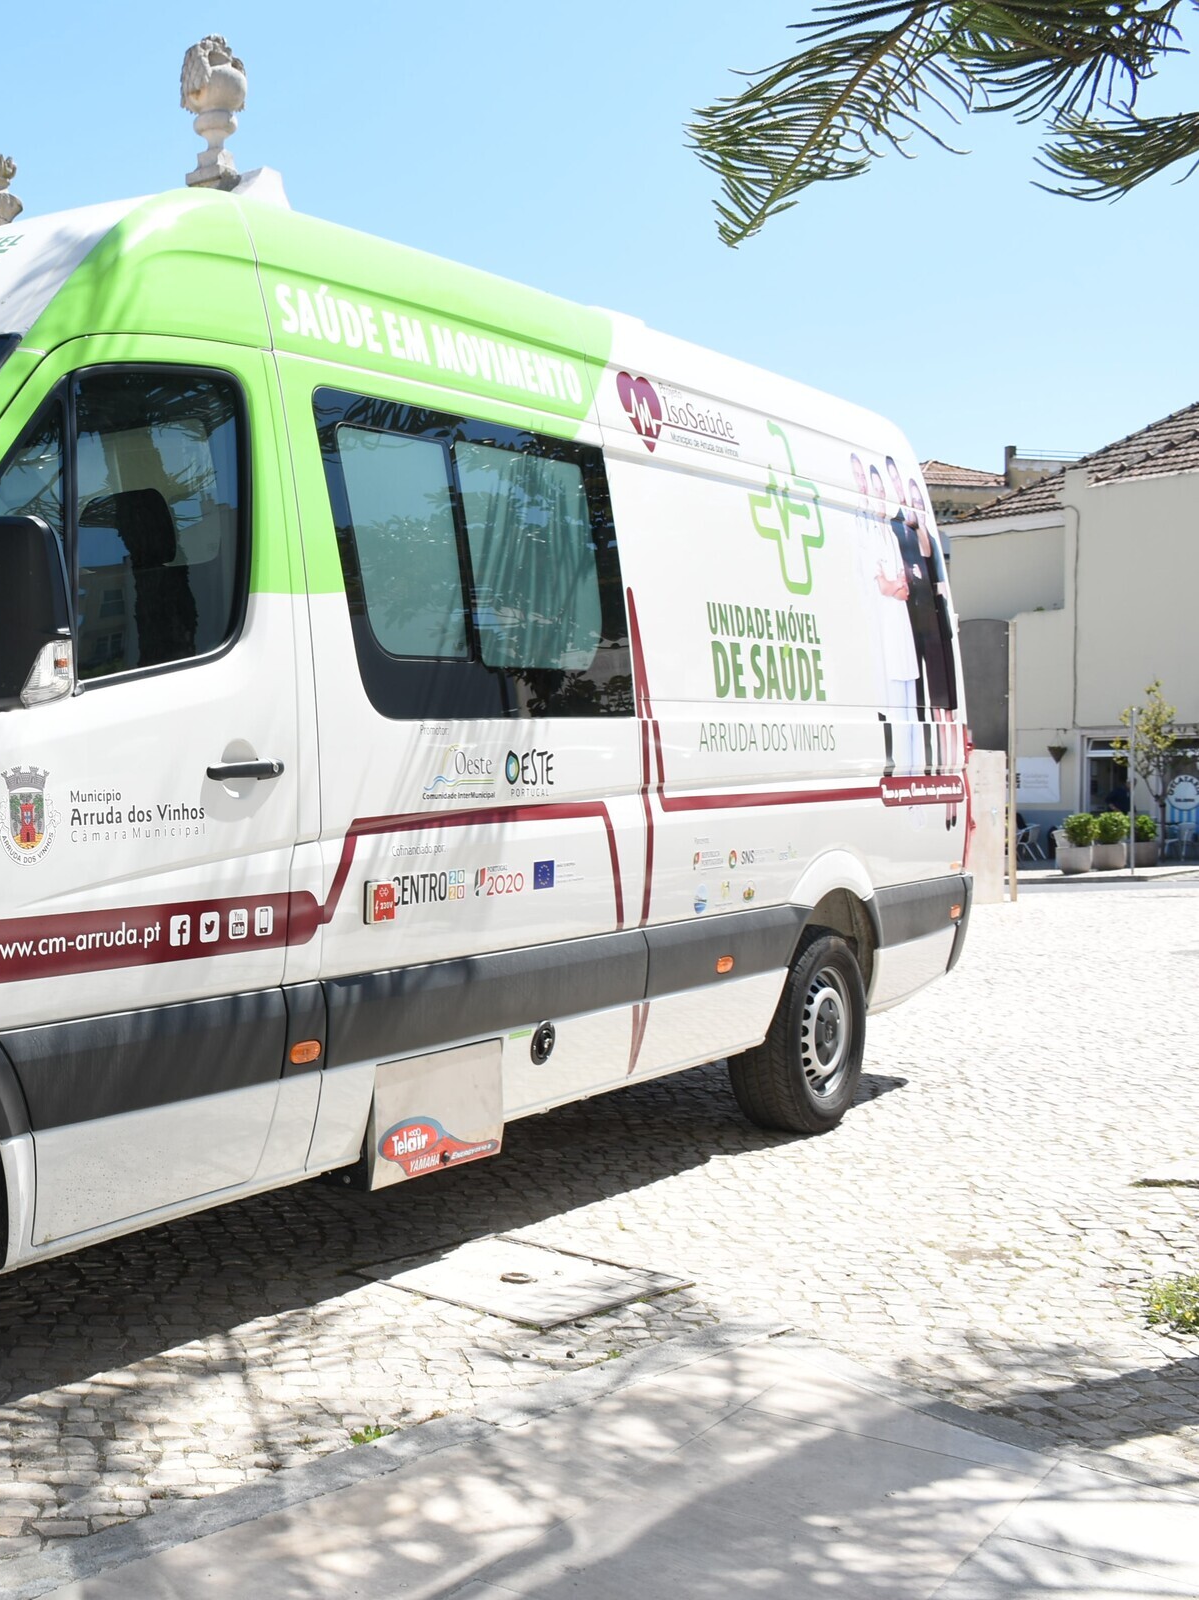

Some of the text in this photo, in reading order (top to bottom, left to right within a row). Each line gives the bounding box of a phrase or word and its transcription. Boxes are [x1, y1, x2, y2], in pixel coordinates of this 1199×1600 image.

[275, 283, 583, 405] SAÚDE EM MOVIMENTO
[661, 395, 736, 439] IsoSaúde
[706, 601, 821, 645] UNIDADE MÓVEL
[711, 640, 827, 702] DE SAÚDE
[699, 722, 836, 752] ARRUDA DOS VINHOS
[455, 748, 554, 786] Oeste OESTE
[70, 789, 121, 804] Município
[422, 791, 457, 800] Comunidade
[510, 788, 550, 798] PORTUGAL
[70, 802, 205, 826] Arruda dos Vinhos
[132, 824, 206, 840] Municipal
[2, 835, 21, 861] ARRUDA
[23, 855, 37, 863] DOS
[392, 843, 433, 857] Cofinanciado
[740, 849, 755, 865] SNS
[392, 871, 448, 907] CENTRO
[486, 872, 524, 897] 2020
[392, 1130, 429, 1156] Telair
[409, 1153, 441, 1173] YAMAHA
